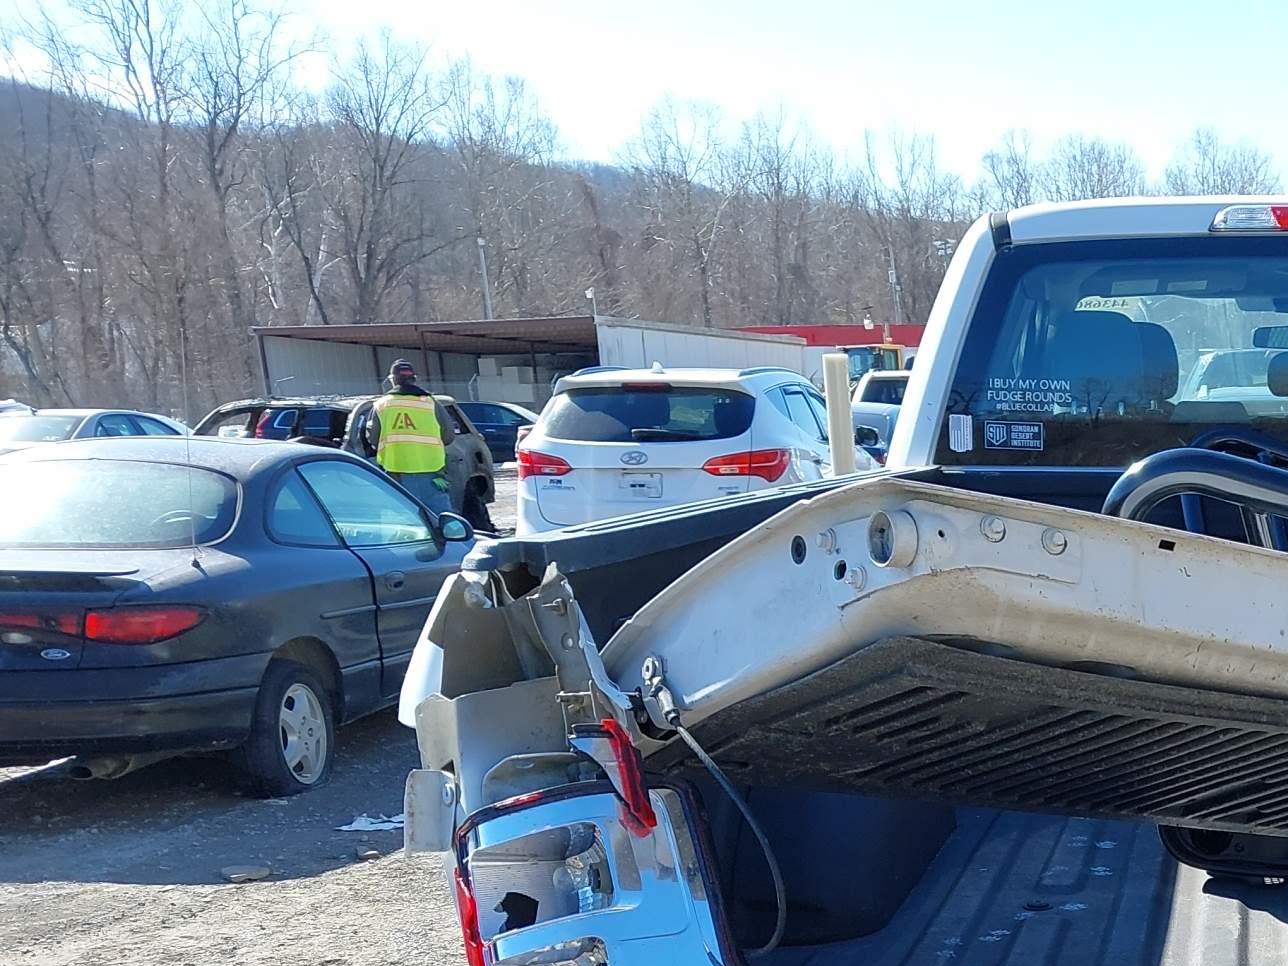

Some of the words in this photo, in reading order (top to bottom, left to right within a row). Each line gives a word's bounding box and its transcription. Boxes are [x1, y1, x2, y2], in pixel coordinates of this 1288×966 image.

[994, 378, 1017, 389] BUY
[1018, 379, 1037, 389] MY
[1039, 380, 1070, 390] OWN
[987, 391, 1023, 402] FUDGE
[1025, 392, 1072, 403] ROUNDS
[1011, 424, 1039, 433] SONORAN
[1011, 432, 1034, 440] DESERT
